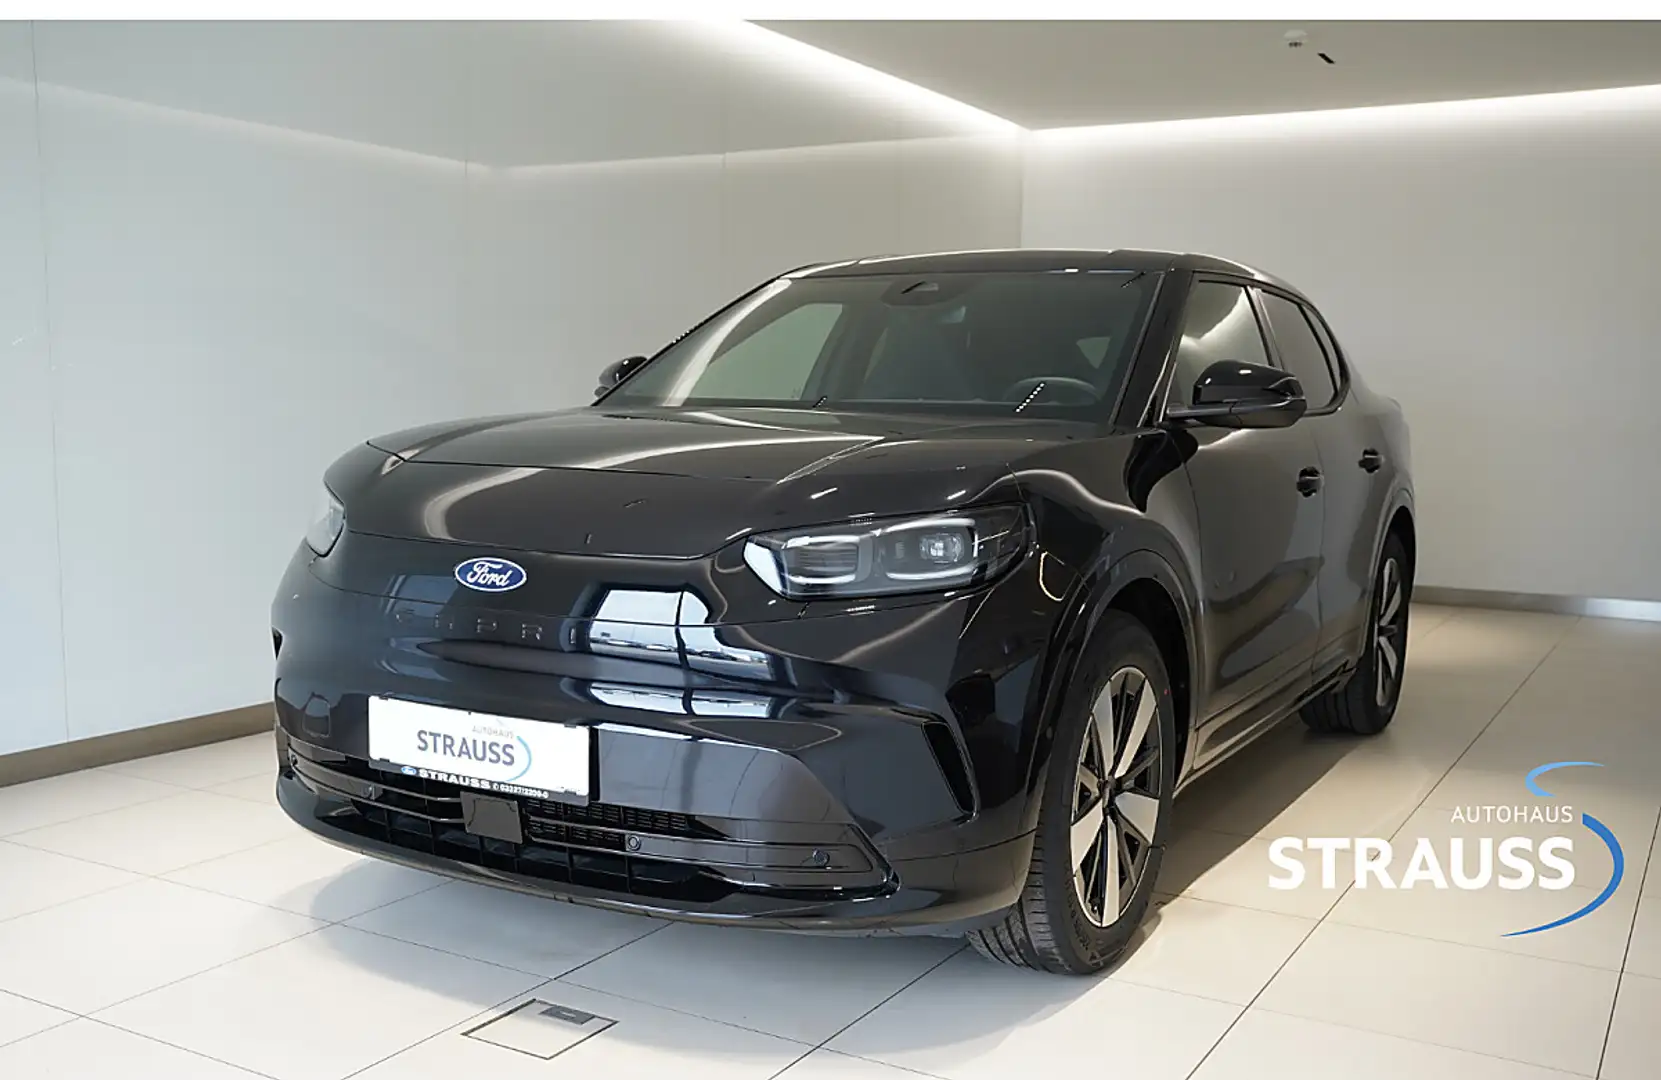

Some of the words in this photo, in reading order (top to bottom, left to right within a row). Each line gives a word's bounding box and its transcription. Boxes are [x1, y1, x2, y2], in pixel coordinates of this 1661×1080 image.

[463, 559, 513, 588] Ford
[472, 725, 515, 739] AUTOHAUS
[417, 730, 515, 766] STRAUSS
[419, 768, 491, 789] STRAUSS
